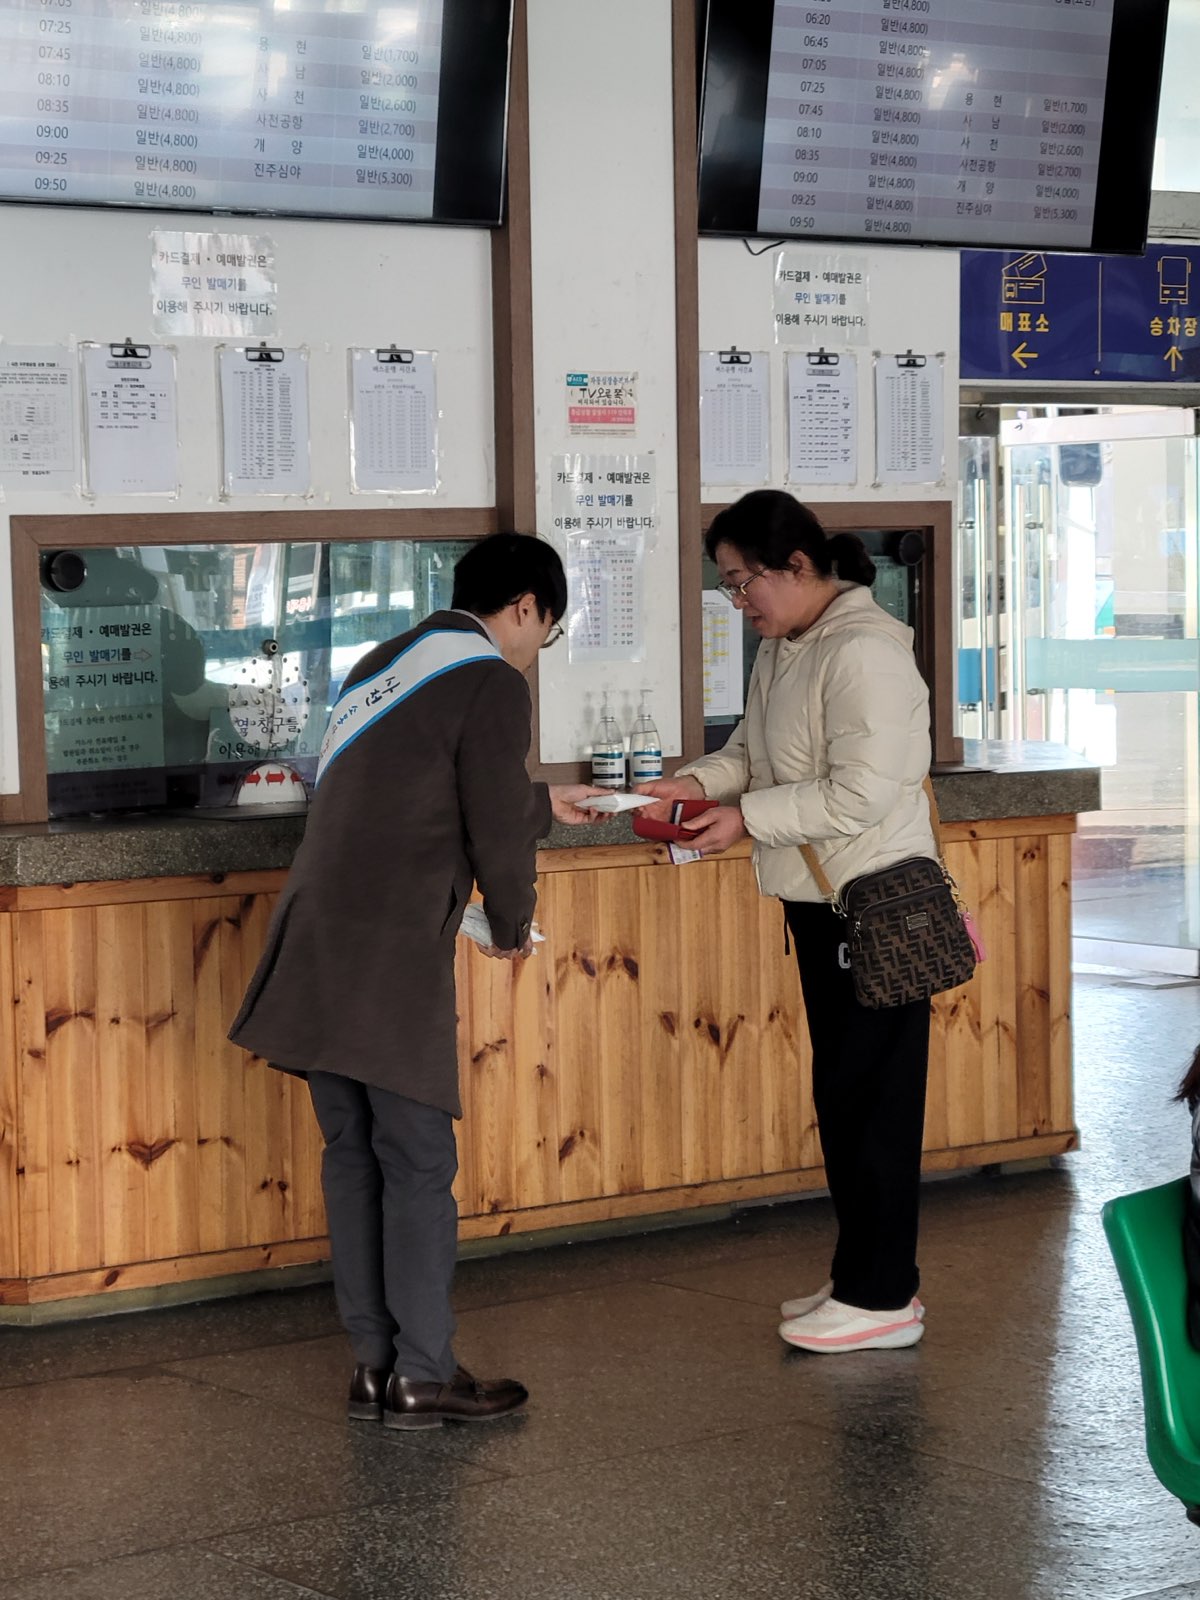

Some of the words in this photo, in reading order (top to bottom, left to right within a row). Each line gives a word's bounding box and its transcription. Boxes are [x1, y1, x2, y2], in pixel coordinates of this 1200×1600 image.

[39, 20, 71, 34] 07:25
[805, 13, 831, 25] 06:20
[881, 18, 928, 35] 일반(4,800)
[803, 36, 829, 48] 06:45
[39, 46, 71, 61] 07:45
[802, 58, 827, 72] 07:05
[877, 62, 925, 79] 일반(4,800)
[38, 72, 70, 87] 08:10
[800, 81, 825, 94] 07:25
[875, 85, 923, 102] 일반(4,800)
[37, 98, 69, 114] 08:35
[798, 104, 823, 117] 07:45
[873, 108, 921, 125] 일반(4,800)
[36, 125, 69, 140] 09:00
[797, 127, 822, 140] 08:10
[871, 130, 919, 147] 일반(4,800)
[254, 138, 265, 153] 개
[35, 151, 67, 166] 09:25
[795, 149, 820, 162] 08:35
[870, 151, 917, 168] 일반(4,800)
[253, 162, 301, 180] 진주심야
[34, 177, 67, 192] 09:50
[793, 171, 818, 184] 09:00
[868, 174, 915, 191] 일반(4,800)
[791, 193, 816, 207] 09:25
[866, 195, 913, 213] 일반(4,800)
[955, 201, 992, 217] 진주심야
[789, 216, 815, 229] 09:50
[864, 217, 912, 235] 일반(4,800)
[159, 251, 200, 266] 카드결제
[216, 253, 268, 268] 예매발권은
[181, 276, 201, 290] 무인
[206, 278, 247, 292] 발매기를
[779, 270, 811, 283] 카드결제
[823, 271, 862, 284] 예매발권은
[156, 299, 188, 314] 이용해
[193, 301, 224, 314] 주시기
[794, 292, 811, 304] 무인
[815, 293, 847, 306] 발매기를
[775, 313, 800, 326] 이용해
[804, 314, 828, 326] 주시기
[1000, 312, 1050, 333] 매표소
[1150, 316, 1198, 337] 승차장
[606, 472, 651, 485] 예매발권은
[576, 494, 594, 507] 무인
[598, 494, 634, 507] 발매기를
[554, 517, 582, 530] 이용해
[586, 517, 613, 529] 주시기
[99, 622, 152, 638] 예매발권은
[64, 650, 84, 664] 무인
[89, 648, 132, 663] 발매기를
[49, 676, 70, 690] 용해
[75, 673, 107, 688] 주시기
[258, 717, 299, 734] 창구를
[219, 742, 260, 759] 이용해
